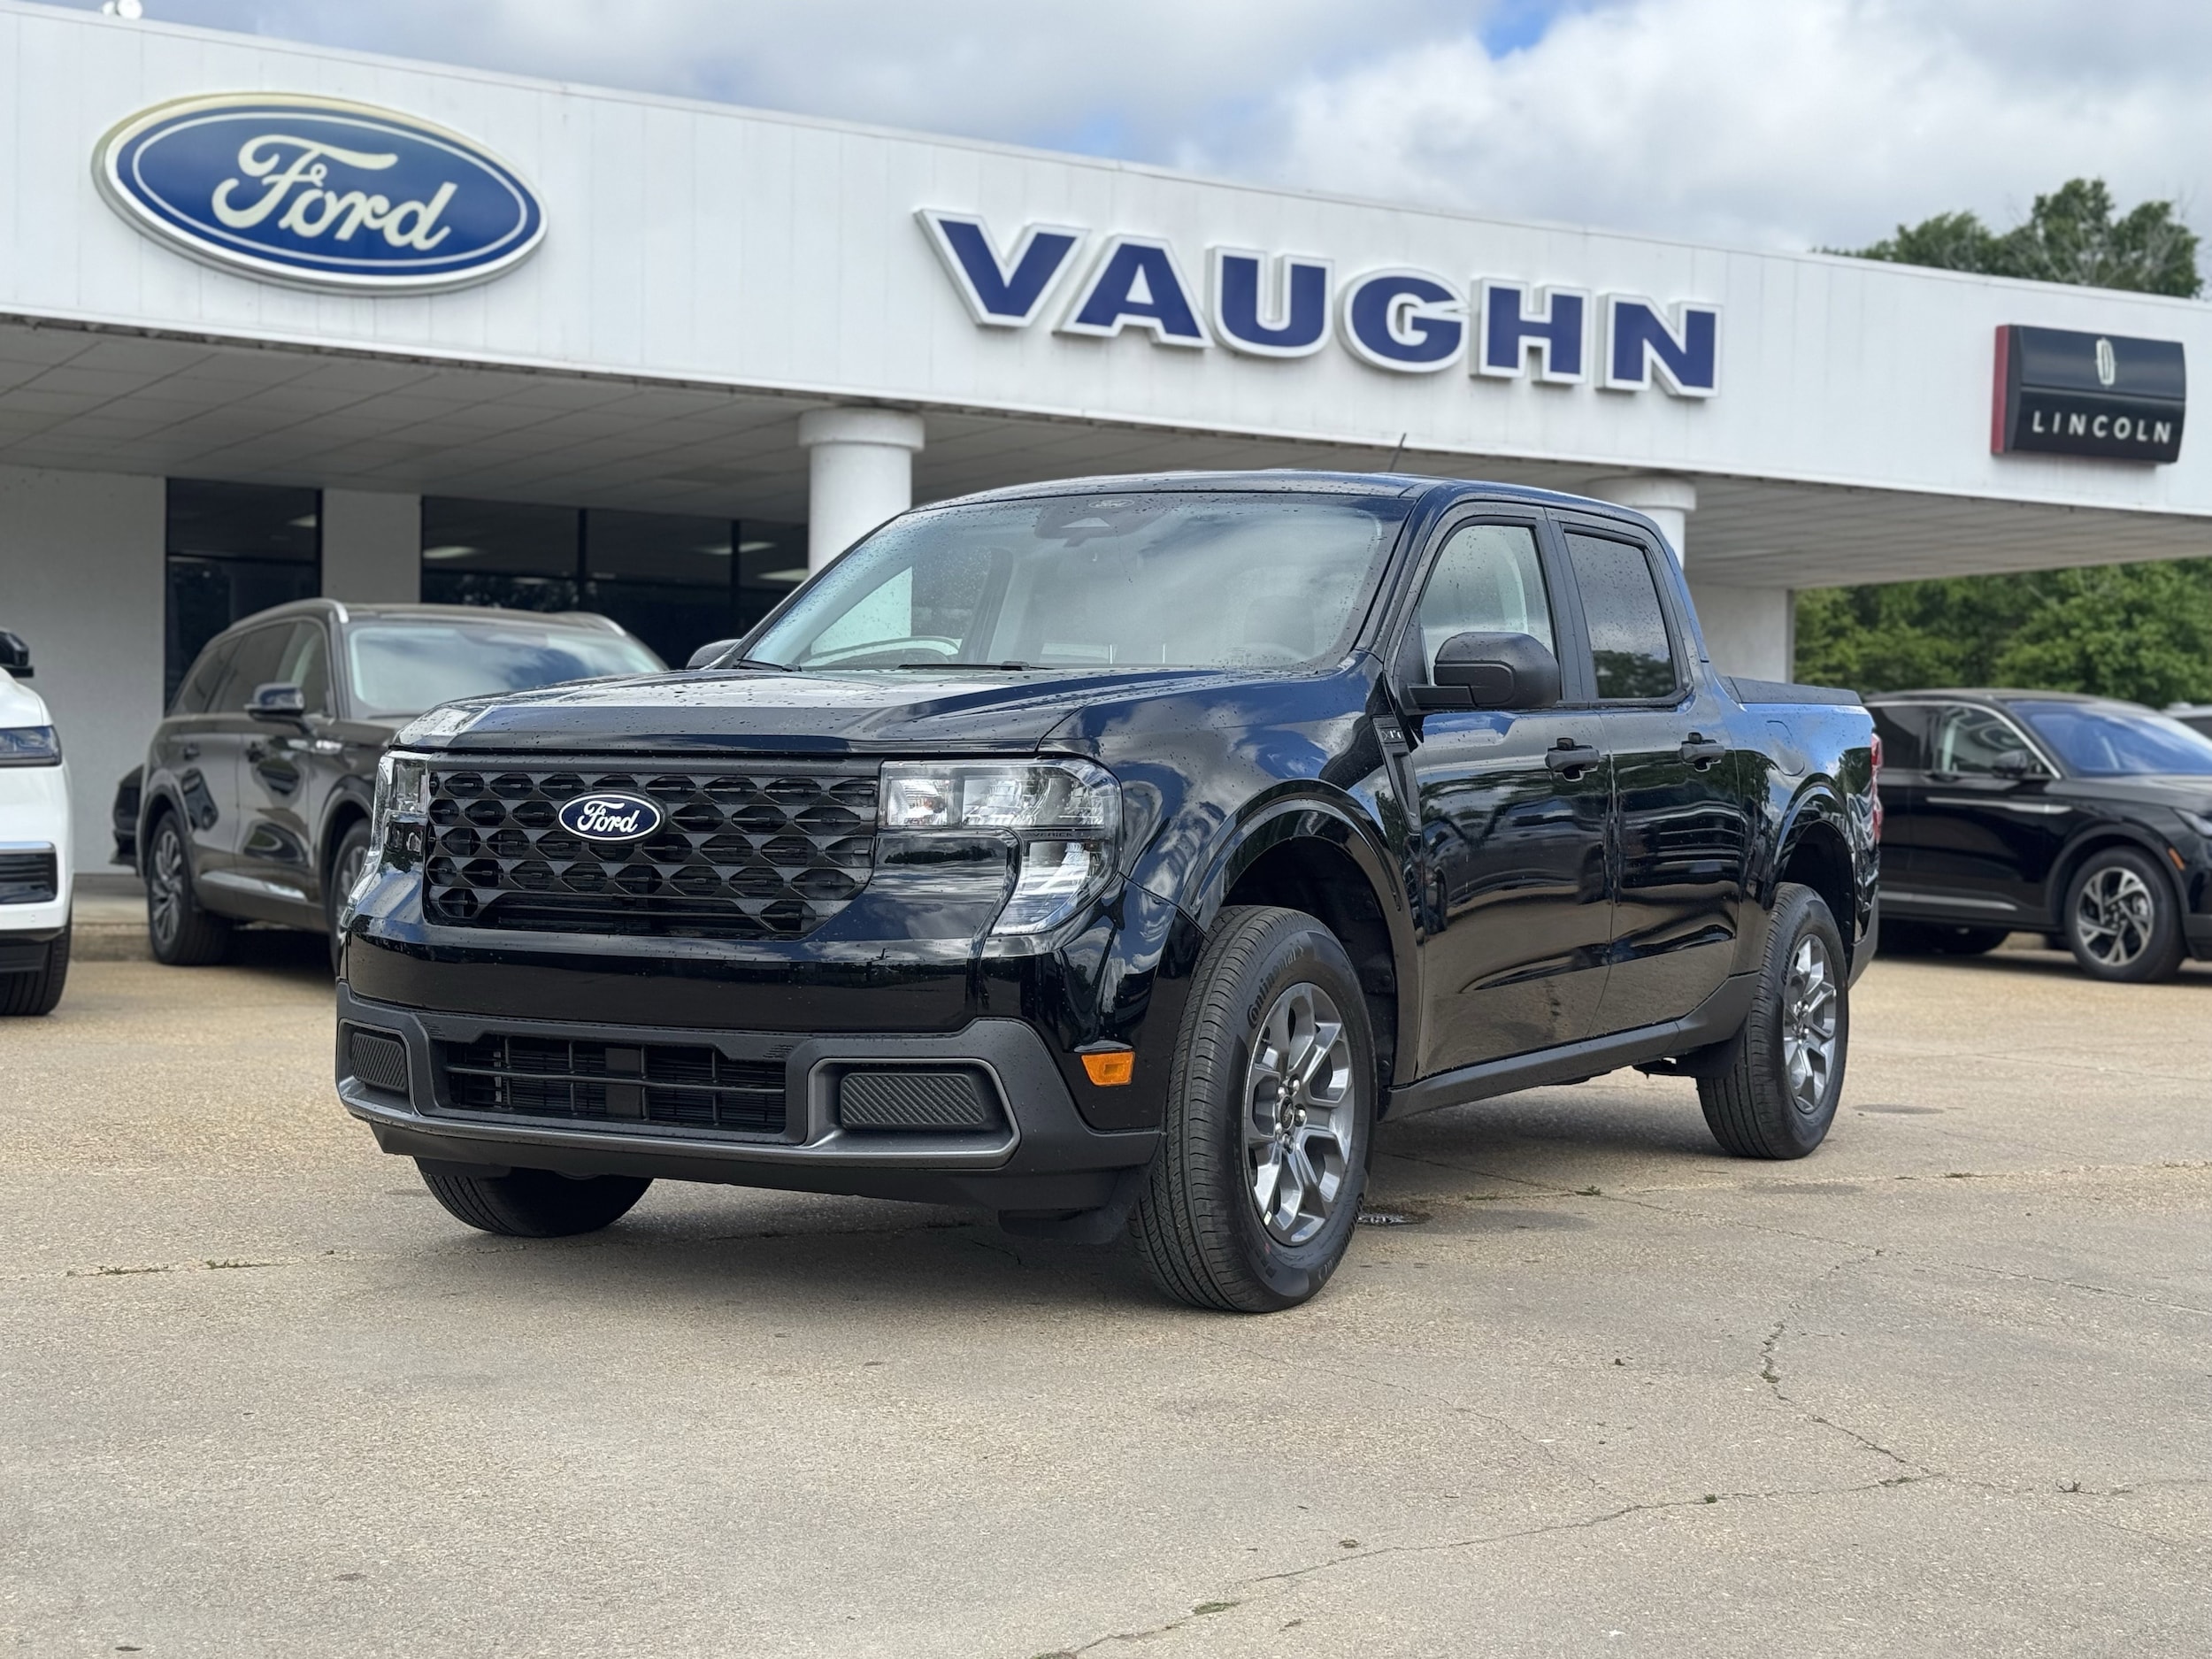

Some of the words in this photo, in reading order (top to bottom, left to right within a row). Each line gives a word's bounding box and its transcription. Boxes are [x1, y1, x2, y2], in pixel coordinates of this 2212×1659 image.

[211, 134, 457, 251] Ford
[914, 209, 1724, 398] VAUGHN
[2032, 410, 2172, 444] LINCOLN
[577, 800, 641, 833] Ford
